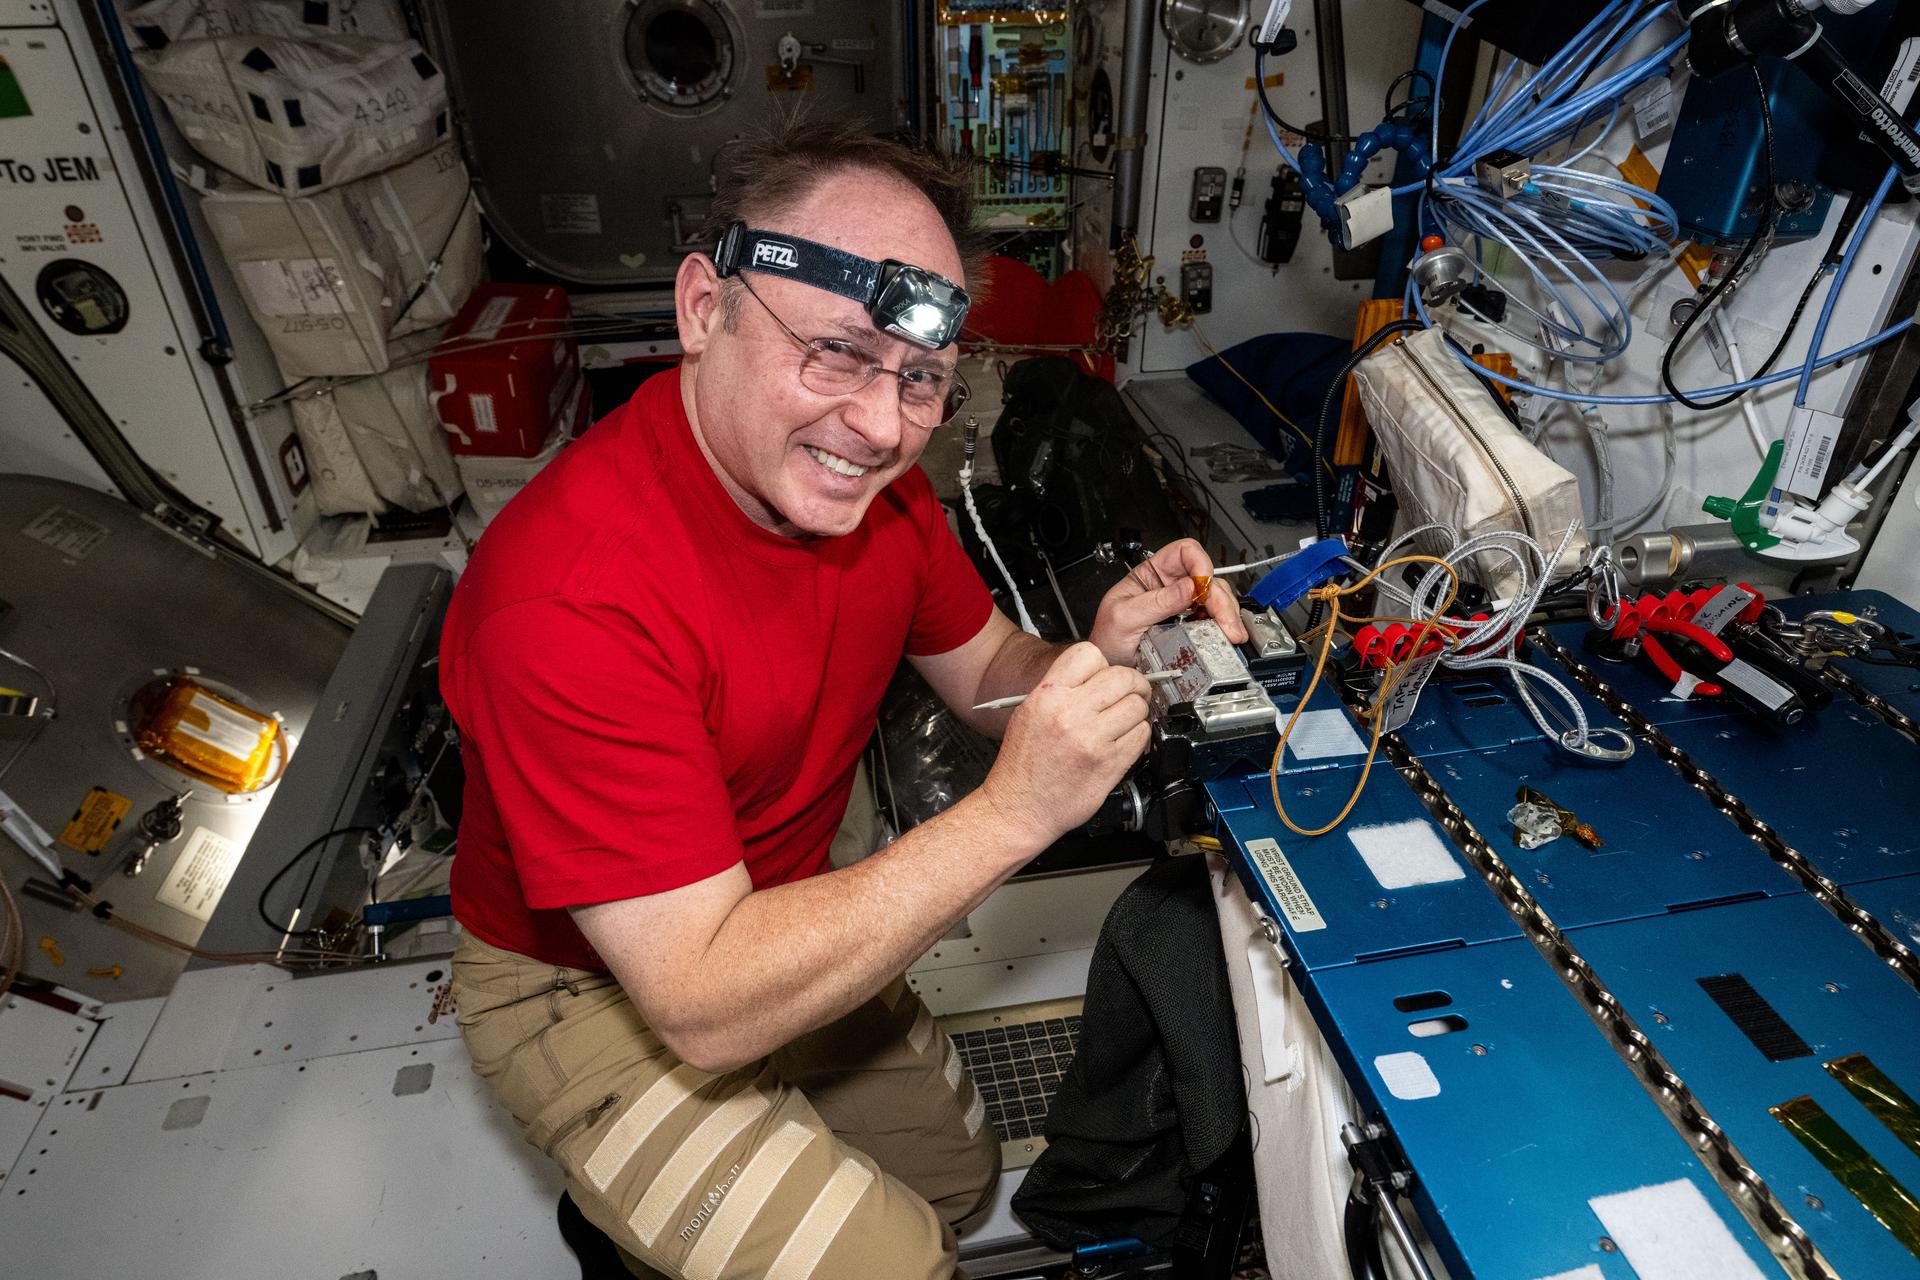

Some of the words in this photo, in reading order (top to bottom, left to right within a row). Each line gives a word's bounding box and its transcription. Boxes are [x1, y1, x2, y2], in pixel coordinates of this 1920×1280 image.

[1870, 106, 1920, 169] Manfrotto
[0, 160, 35, 183] To
[43, 157, 100, 182] JEM
[754, 243, 799, 268] PETZL
[1391, 681, 1410, 712] TAPE
[1254, 849, 1269, 869] USING
[1265, 869, 1277, 884] THIS
[1261, 848, 1276, 865] MUST
[1272, 865, 1281, 875] BE
[1278, 875, 1293, 895] WORN
[1289, 895, 1306, 916] WHEN
[1269, 847, 1285, 867] WRIST
[1281, 866, 1301, 894] GROUND
[1297, 894, 1315, 916] STRAP
